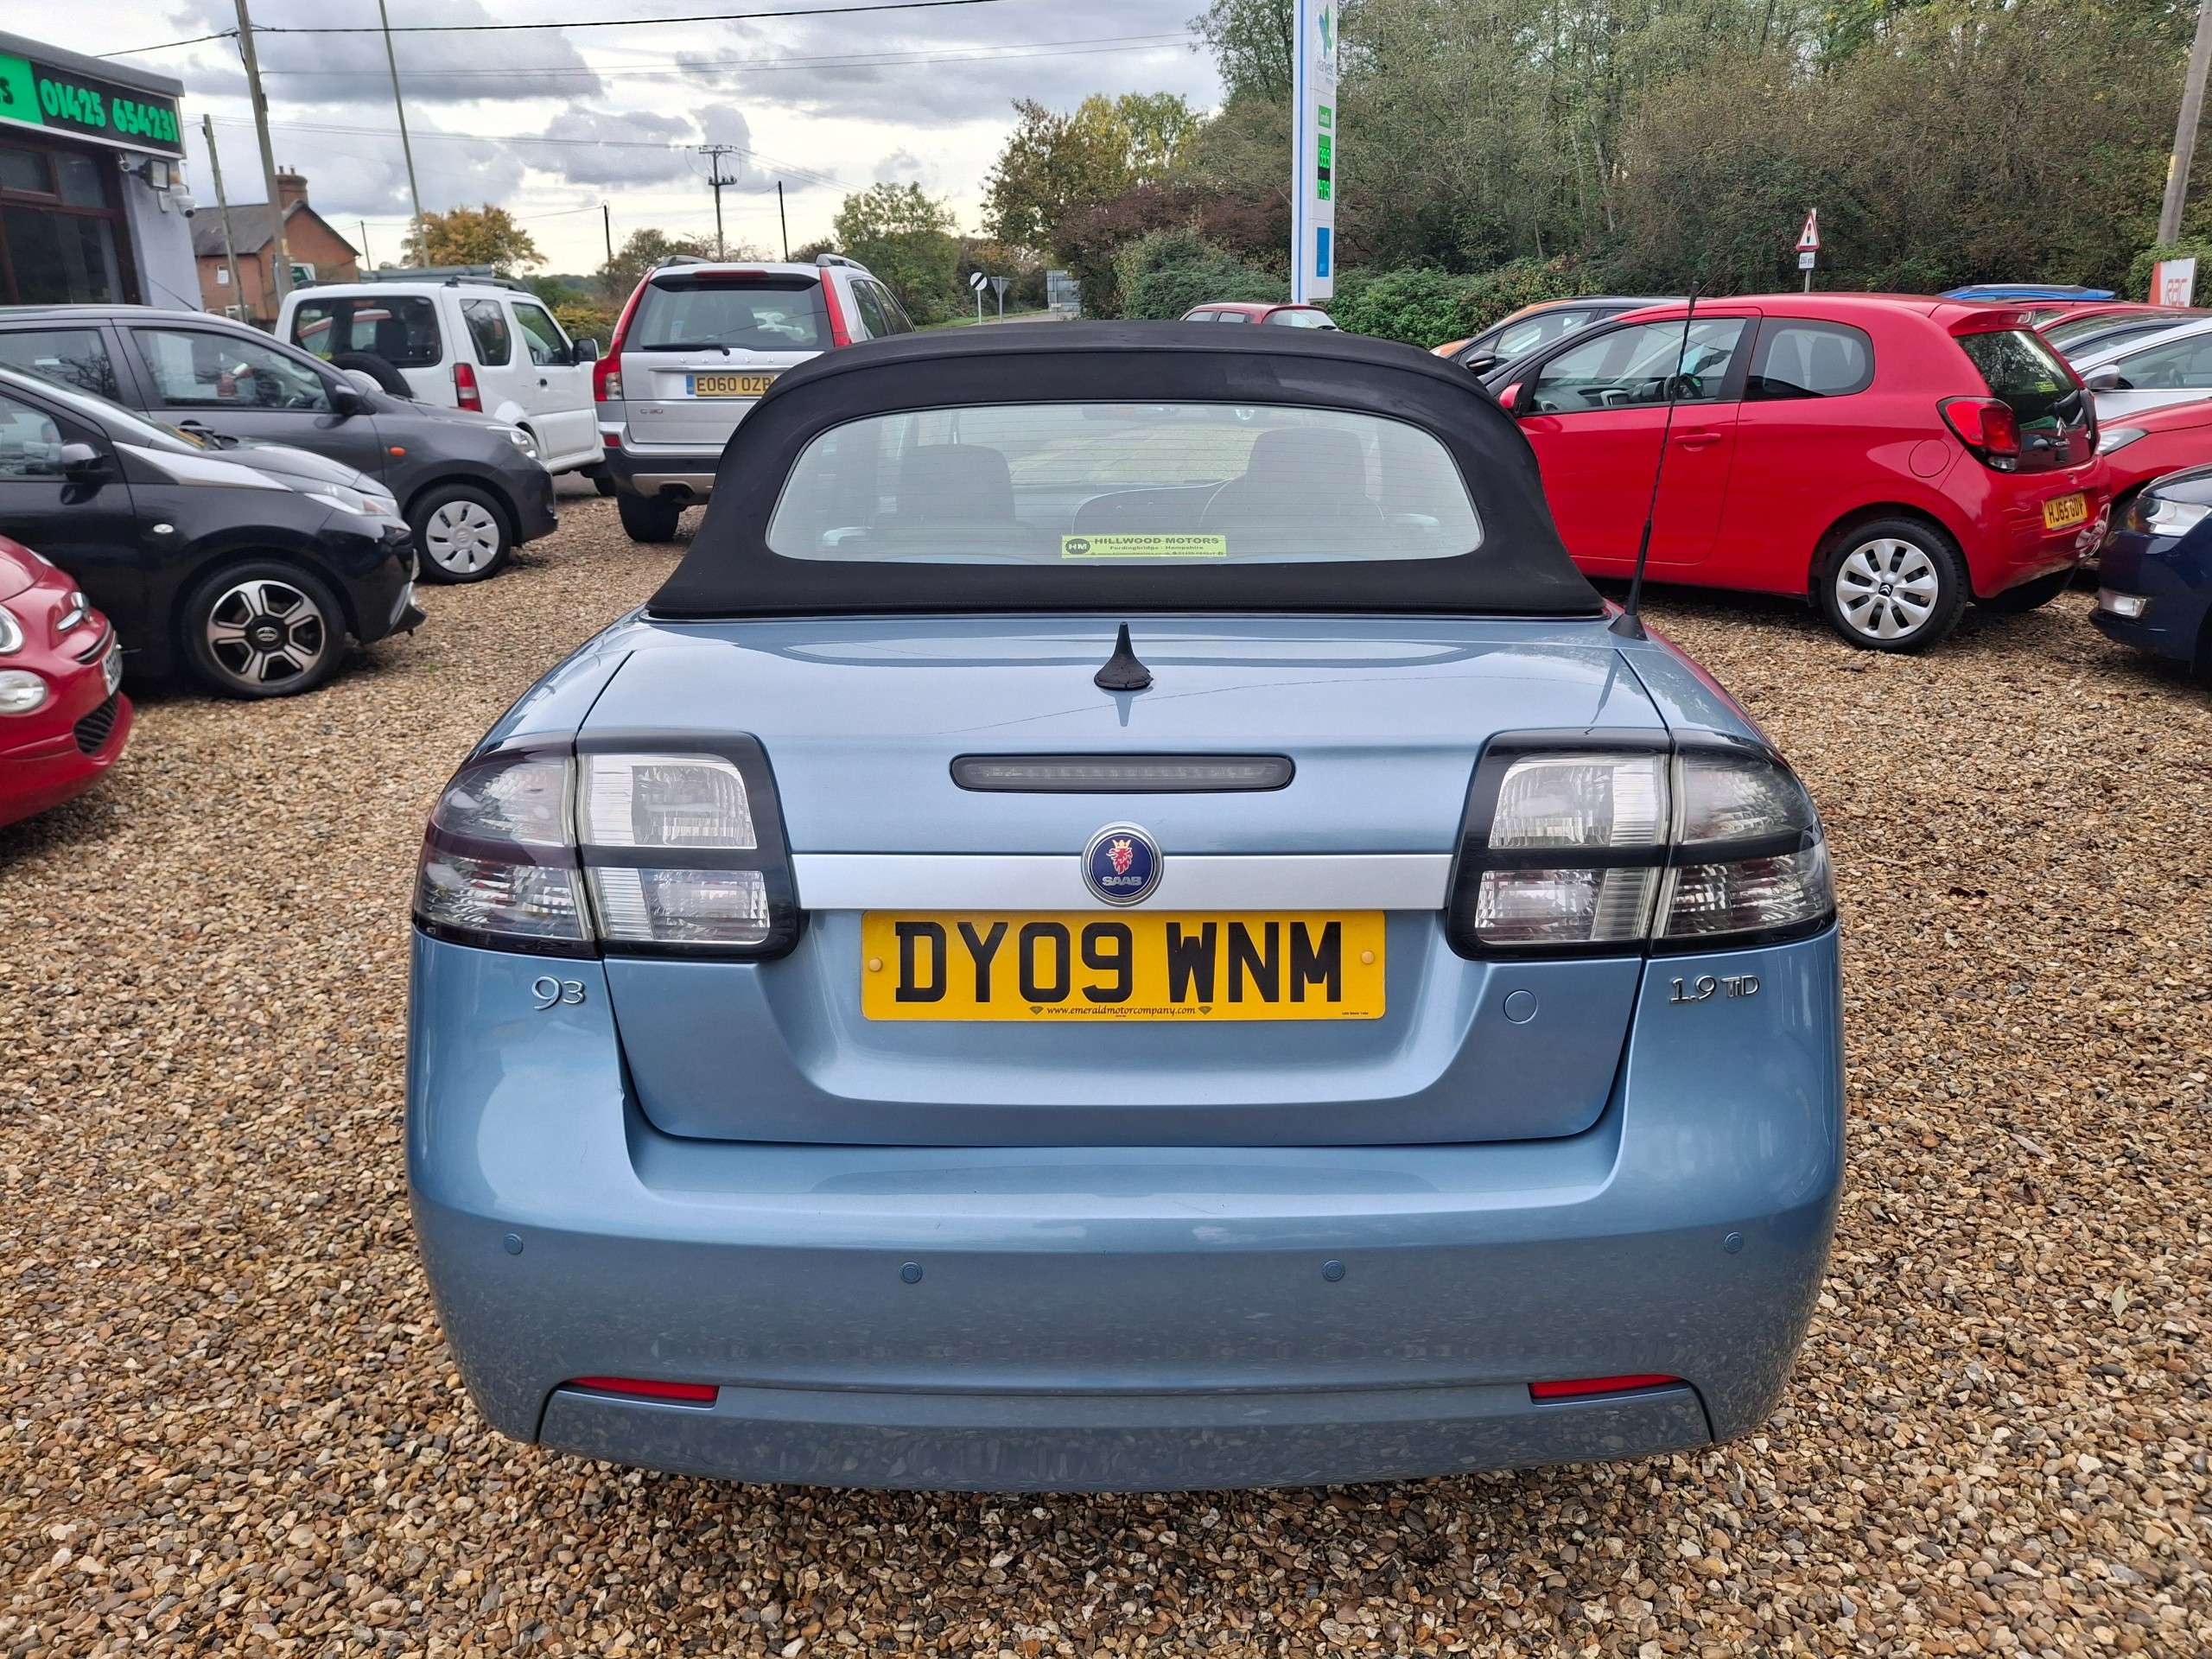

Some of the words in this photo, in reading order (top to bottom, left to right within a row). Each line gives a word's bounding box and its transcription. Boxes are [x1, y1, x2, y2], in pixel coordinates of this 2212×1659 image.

[40, 79, 106, 127] 01425
[112, 97, 180, 143] 654231
[2047, 500, 2069, 524] HJ65
[1102, 876, 1142, 887] SAAB
[895, 921, 1133, 1003] DY09
[1166, 921, 1342, 1003] WNM
[1669, 975, 1717, 1003] 1.9
[1046, 1006, 1196, 1017] www.emeraldmotorcompany.com
